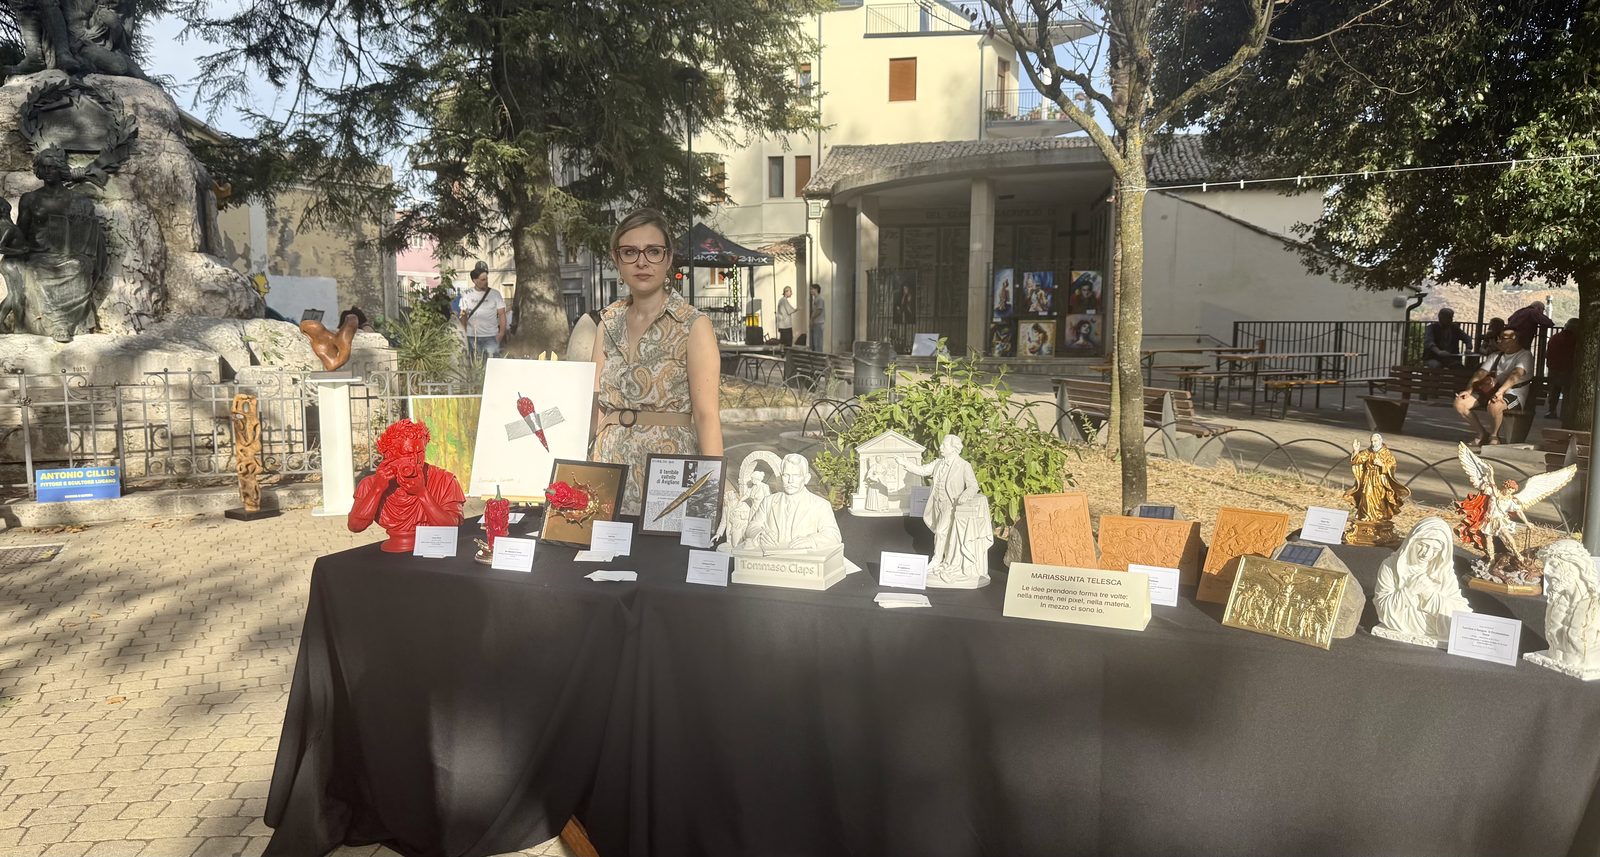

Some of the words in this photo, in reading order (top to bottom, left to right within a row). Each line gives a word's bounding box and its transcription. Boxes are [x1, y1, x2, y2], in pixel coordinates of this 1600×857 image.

[41, 471, 83, 480] ANTONIO
[86, 469, 115, 478] CILLIS
[741, 560, 786, 572] Tommaso
[788, 564, 814, 576] Claps
[1031, 572, 1085, 583] MARIASSUNTA
[1087, 577, 1122, 586] TELESCA
[1046, 587, 1078, 596] prendono
